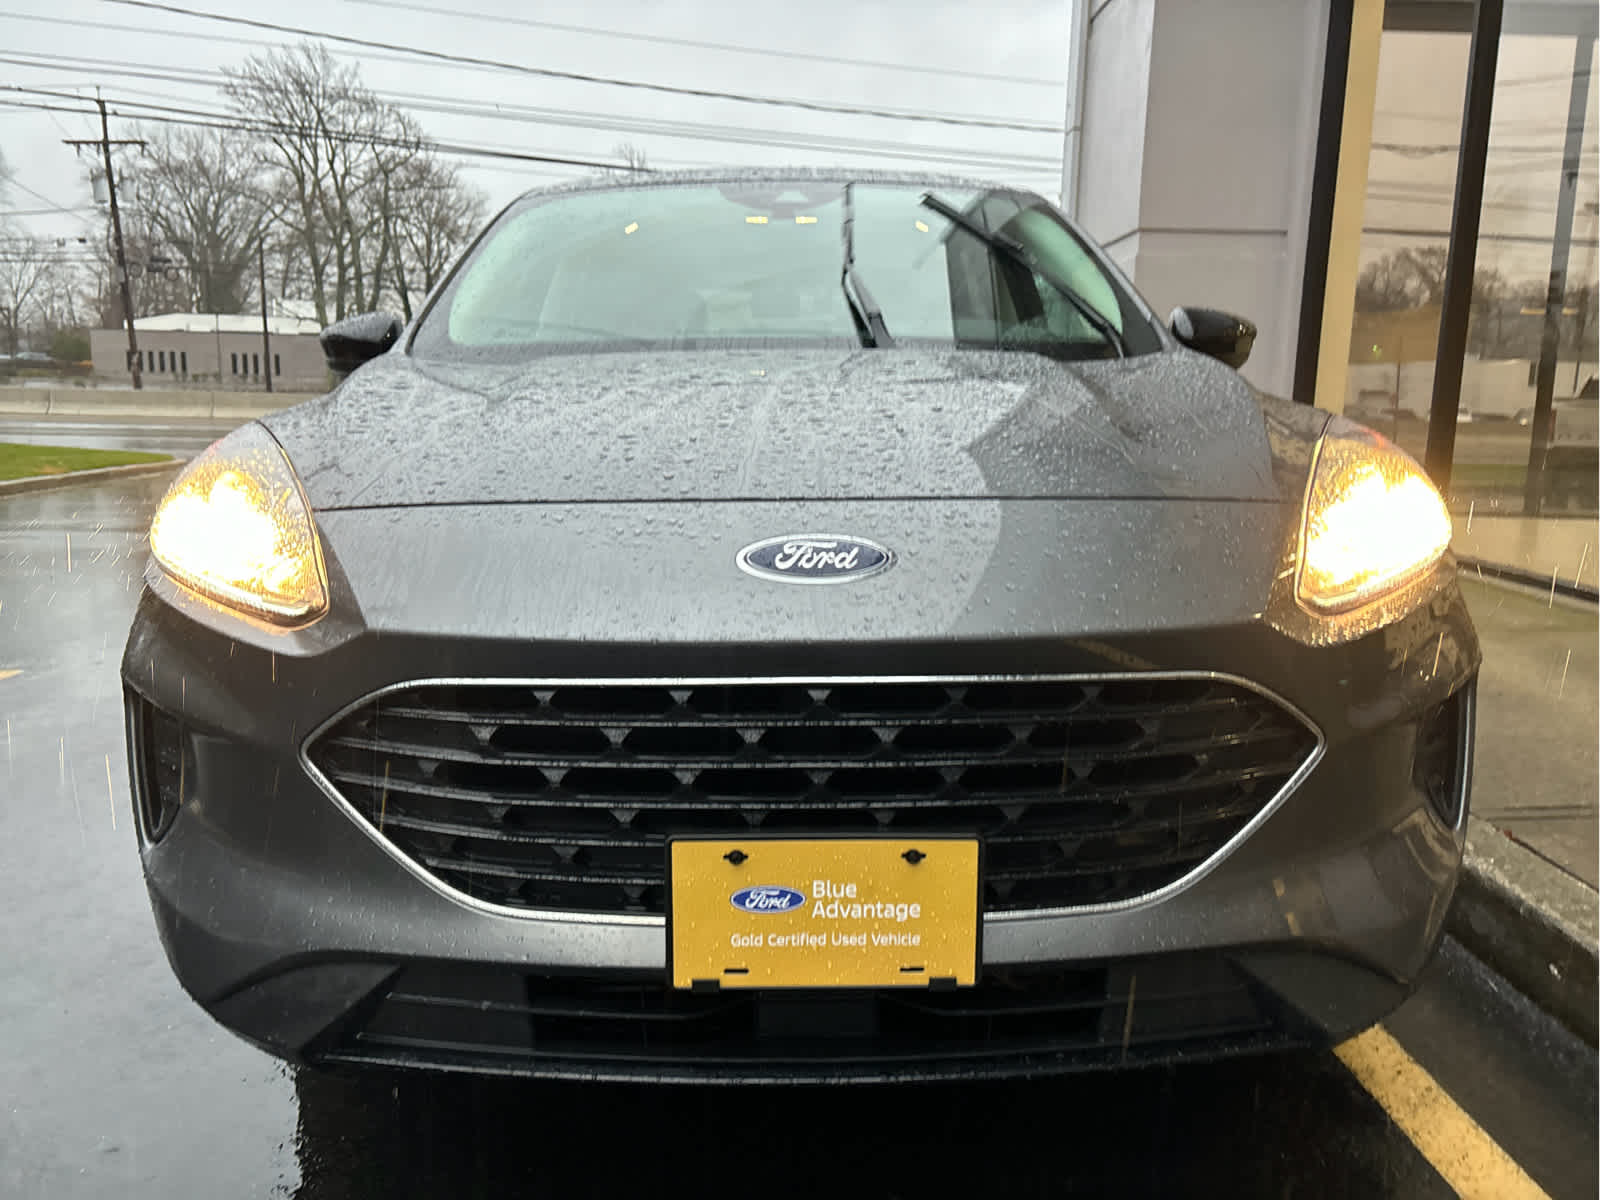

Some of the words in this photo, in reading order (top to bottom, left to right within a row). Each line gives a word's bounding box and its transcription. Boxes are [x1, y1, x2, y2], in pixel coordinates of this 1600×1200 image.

[775, 541, 859, 570] Ford
[745, 888, 790, 911] Ford
[812, 880, 857, 899] Blue
[811, 900, 921, 922] Advantage
[730, 933, 763, 948] Gold
[767, 933, 827, 947] Certified
[831, 932, 867, 946] Used
[871, 931, 921, 946] Vehicle
